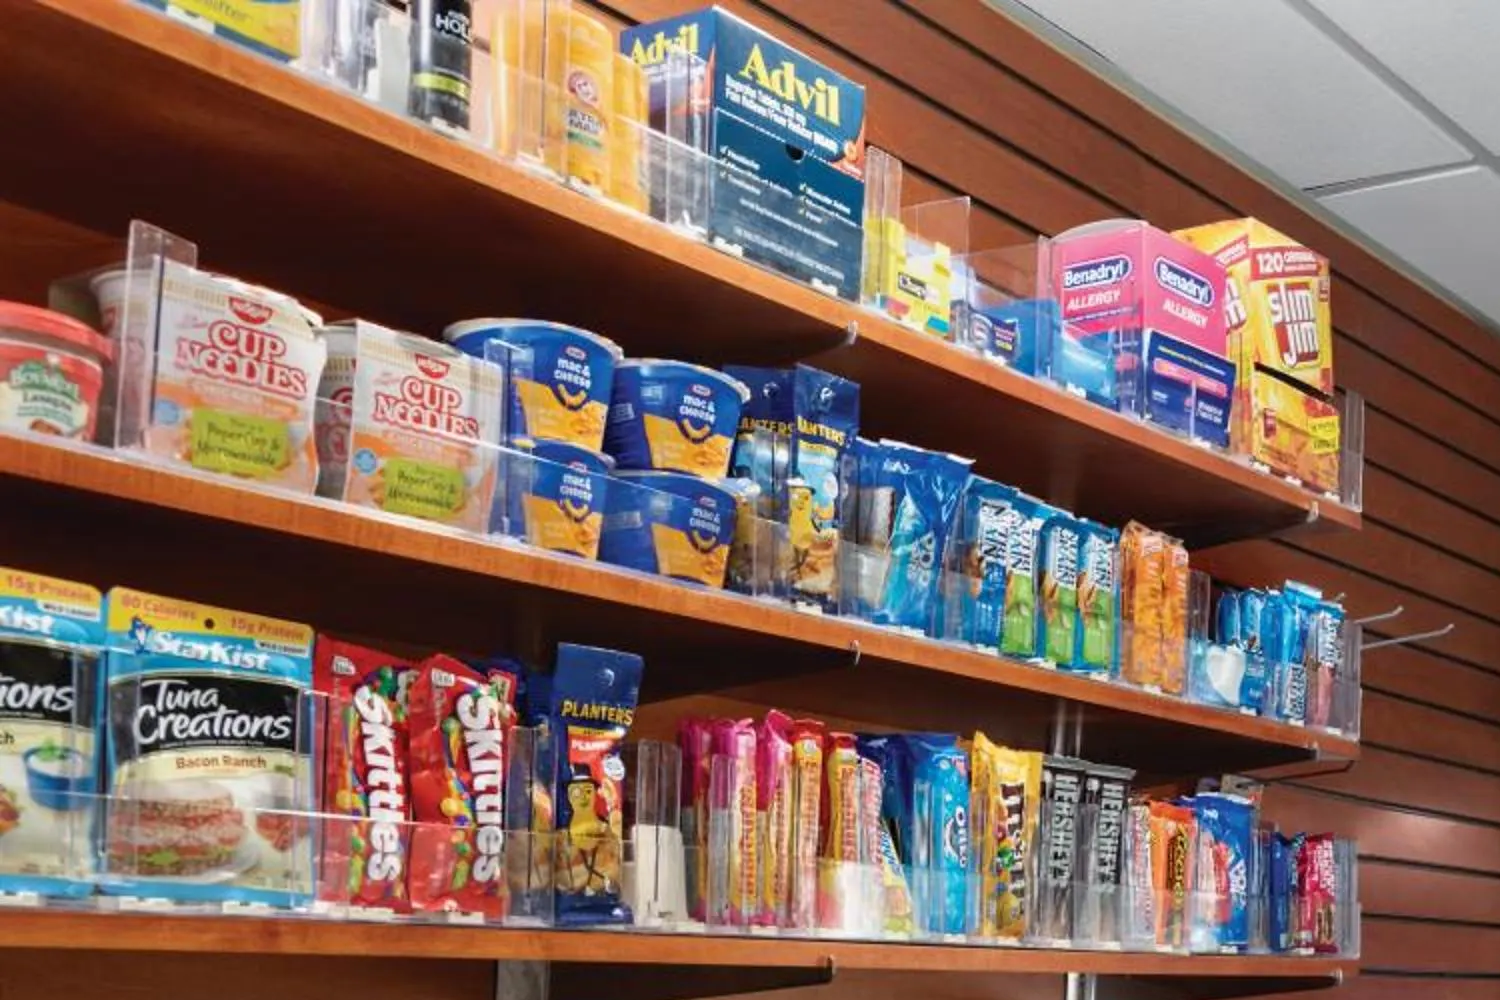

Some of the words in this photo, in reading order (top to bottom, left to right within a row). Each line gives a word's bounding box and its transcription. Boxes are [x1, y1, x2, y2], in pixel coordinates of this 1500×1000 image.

[738, 43, 840, 127] Advil
[1064, 259, 1124, 287] Benadryl
[1257, 252, 1284, 273] 120
[1066, 290, 1121, 311] ALLERGY
[1160, 263, 1210, 302] Benadryl
[1163, 300, 1209, 328] ALLERGY
[208, 320, 287, 362] CUP
[174, 337, 308, 400] NOODLES
[400, 376, 462, 413] CUP
[372, 391, 480, 447] NOODLES
[6, 574, 35, 594] 15g
[38, 578, 92, 602] Protein
[143, 599, 197, 621] Calories
[258, 619, 305, 641] Protein
[149, 630, 270, 672] StarKist
[141, 679, 219, 713] Tuna
[562, 699, 633, 726] PLANTERS
[133, 705, 293, 745] Creations
[175, 756, 219, 770] Bacon
[222, 755, 267, 769] Ranch
[354, 684, 405, 881] Skittles
[457, 692, 504, 882] Skittles
[1051, 773, 1079, 888] HERSHEY'S
